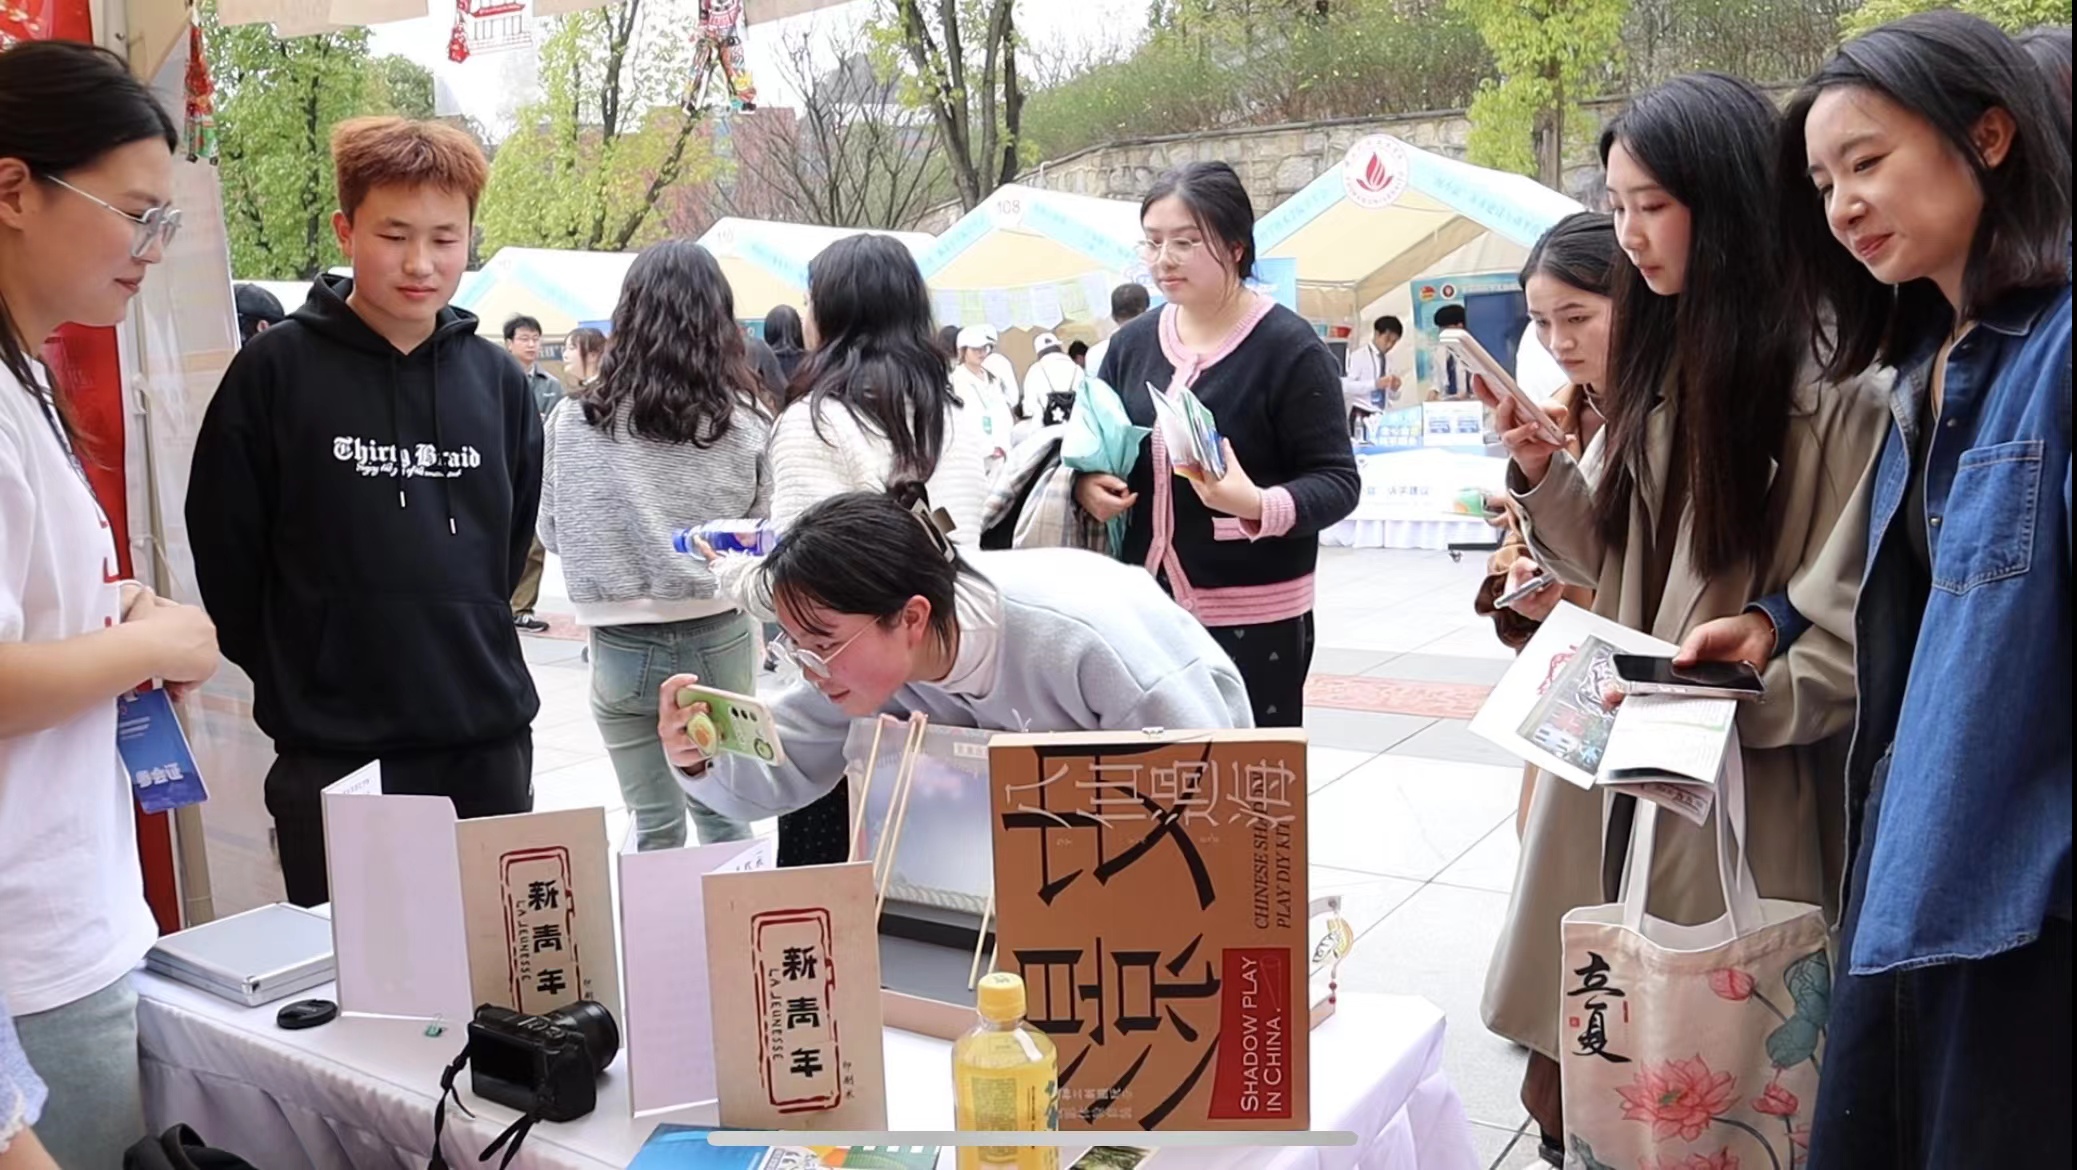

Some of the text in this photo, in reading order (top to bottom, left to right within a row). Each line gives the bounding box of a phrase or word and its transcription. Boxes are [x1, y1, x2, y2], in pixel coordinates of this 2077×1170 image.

[997, 200, 1021, 214] 108
[1005, 759, 1297, 829] 八仙過海
[1254, 853, 1269, 929] CHINESE
[1276, 822, 1291, 928] PLAY DIY KIT
[516, 900, 531, 981] LA JEUNESSE
[528, 880, 566, 995] 新青年
[769, 968, 784, 1060] LA JEUNESSE
[782, 945, 823, 1077] 新青年
[1241, 956, 1258, 1112] SHADOW PLAY
[1567, 951, 1632, 1063] 立夏
[1266, 1092, 1281, 1112] IN
